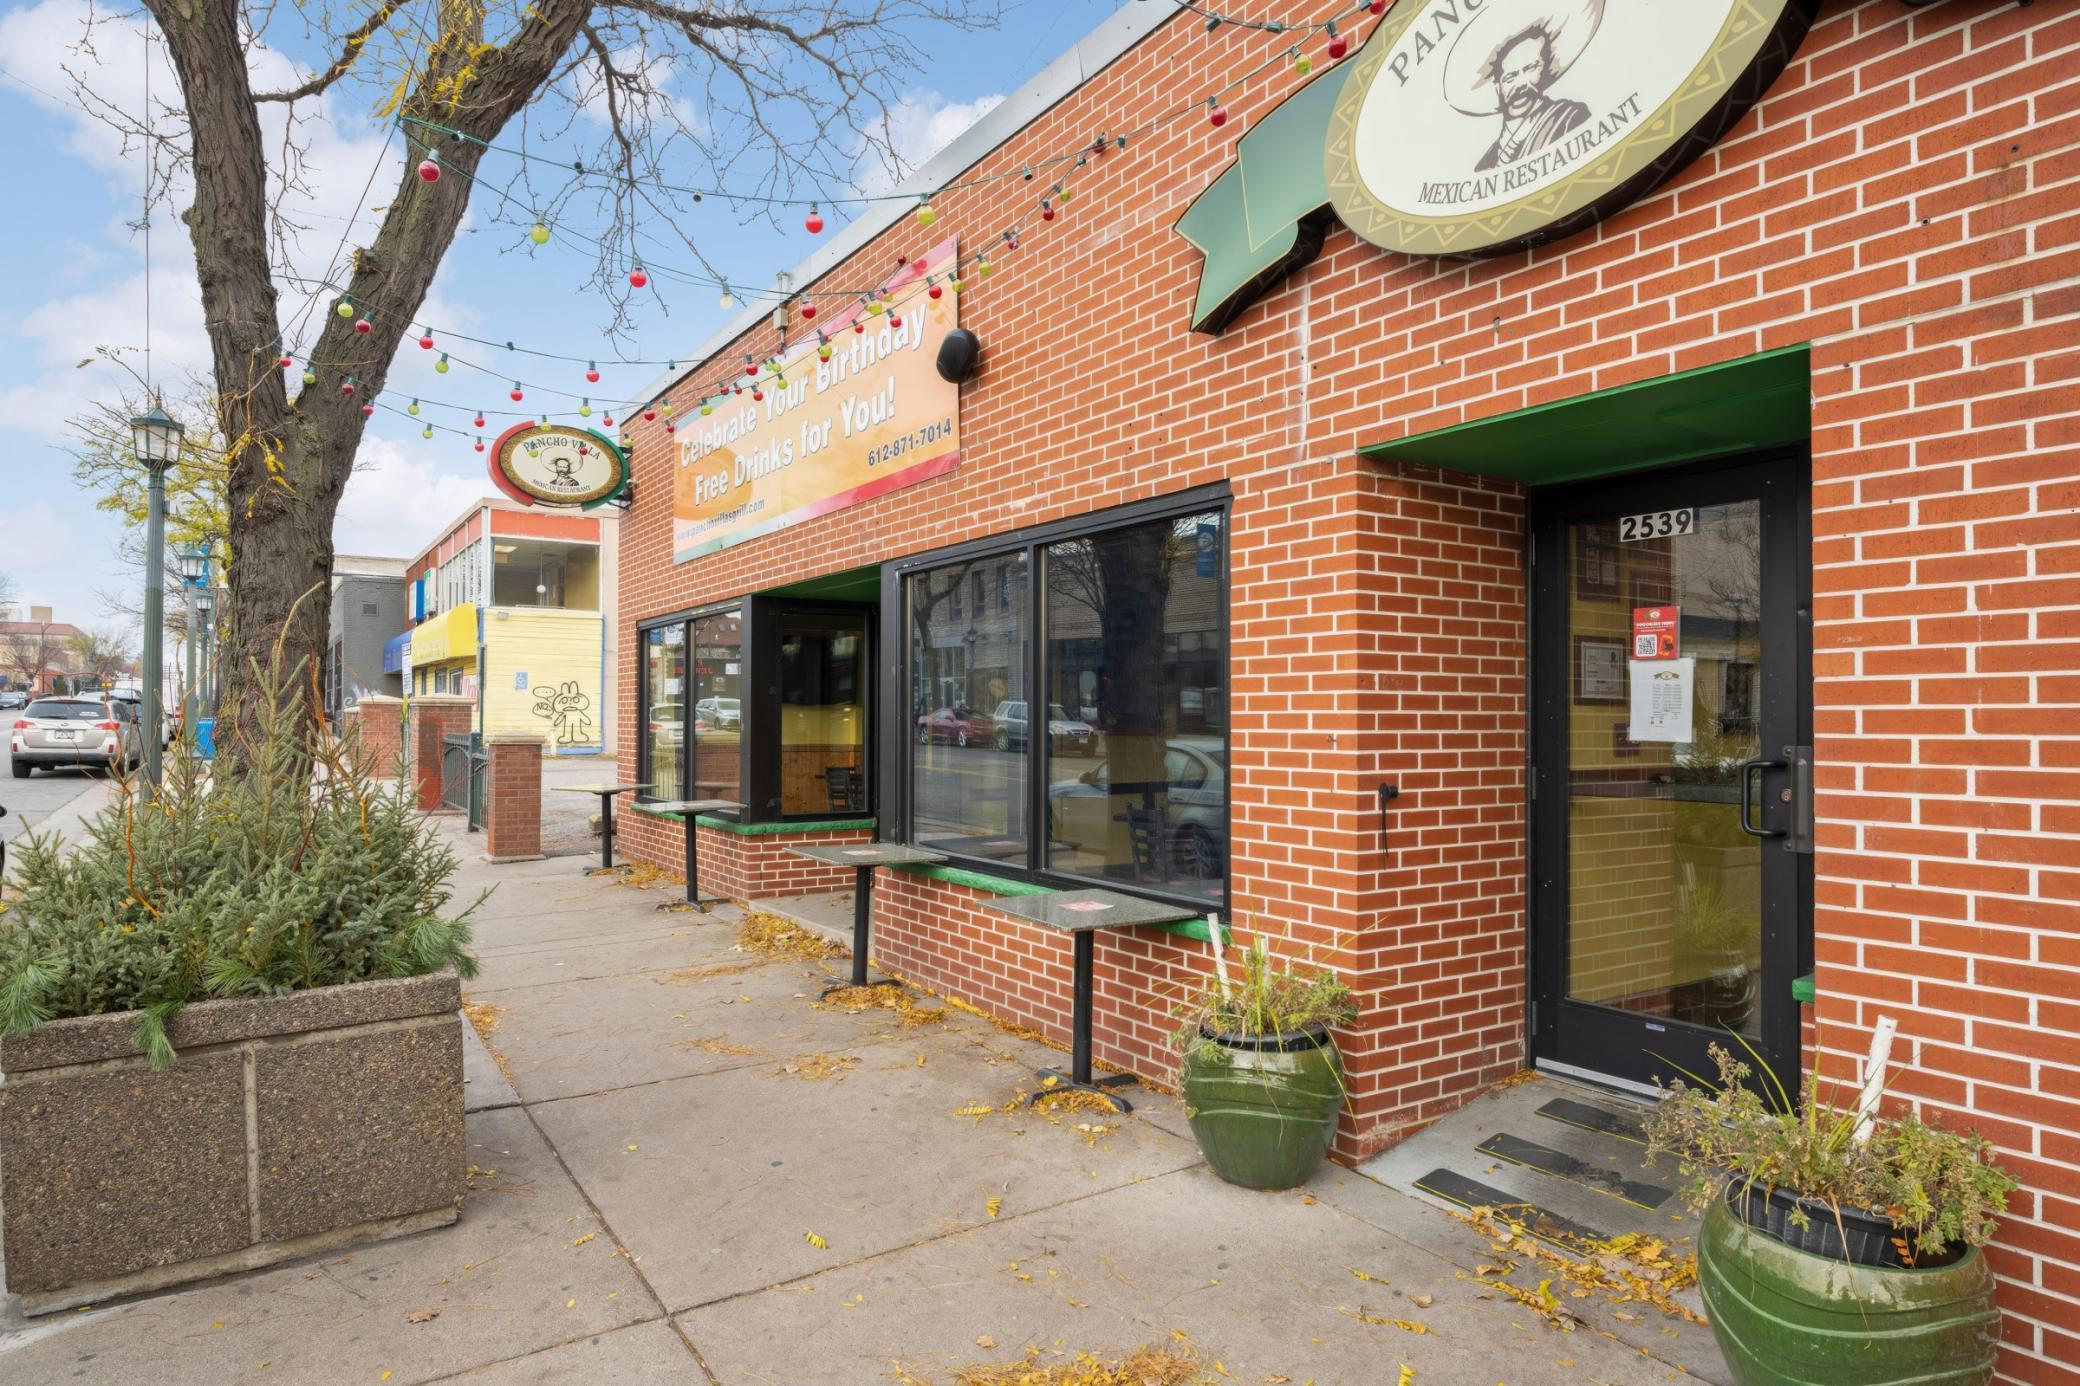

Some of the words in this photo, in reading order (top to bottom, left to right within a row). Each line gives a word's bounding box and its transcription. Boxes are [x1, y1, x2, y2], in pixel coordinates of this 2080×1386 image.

[1417, 174, 1499, 204] MEXICAN
[1502, 92, 1644, 192] RESTAURANT
[681, 405, 757, 468] Celebrate
[764, 374, 809, 422] Your
[816, 303, 927, 395] Birthday
[695, 469, 728, 506] Free
[735, 438, 793, 488] Drinks
[801, 417, 832, 458] for
[840, 375, 895, 439] You!
[523, 437, 567, 452] PANCHO
[1622, 510, 1691, 540] 2539
